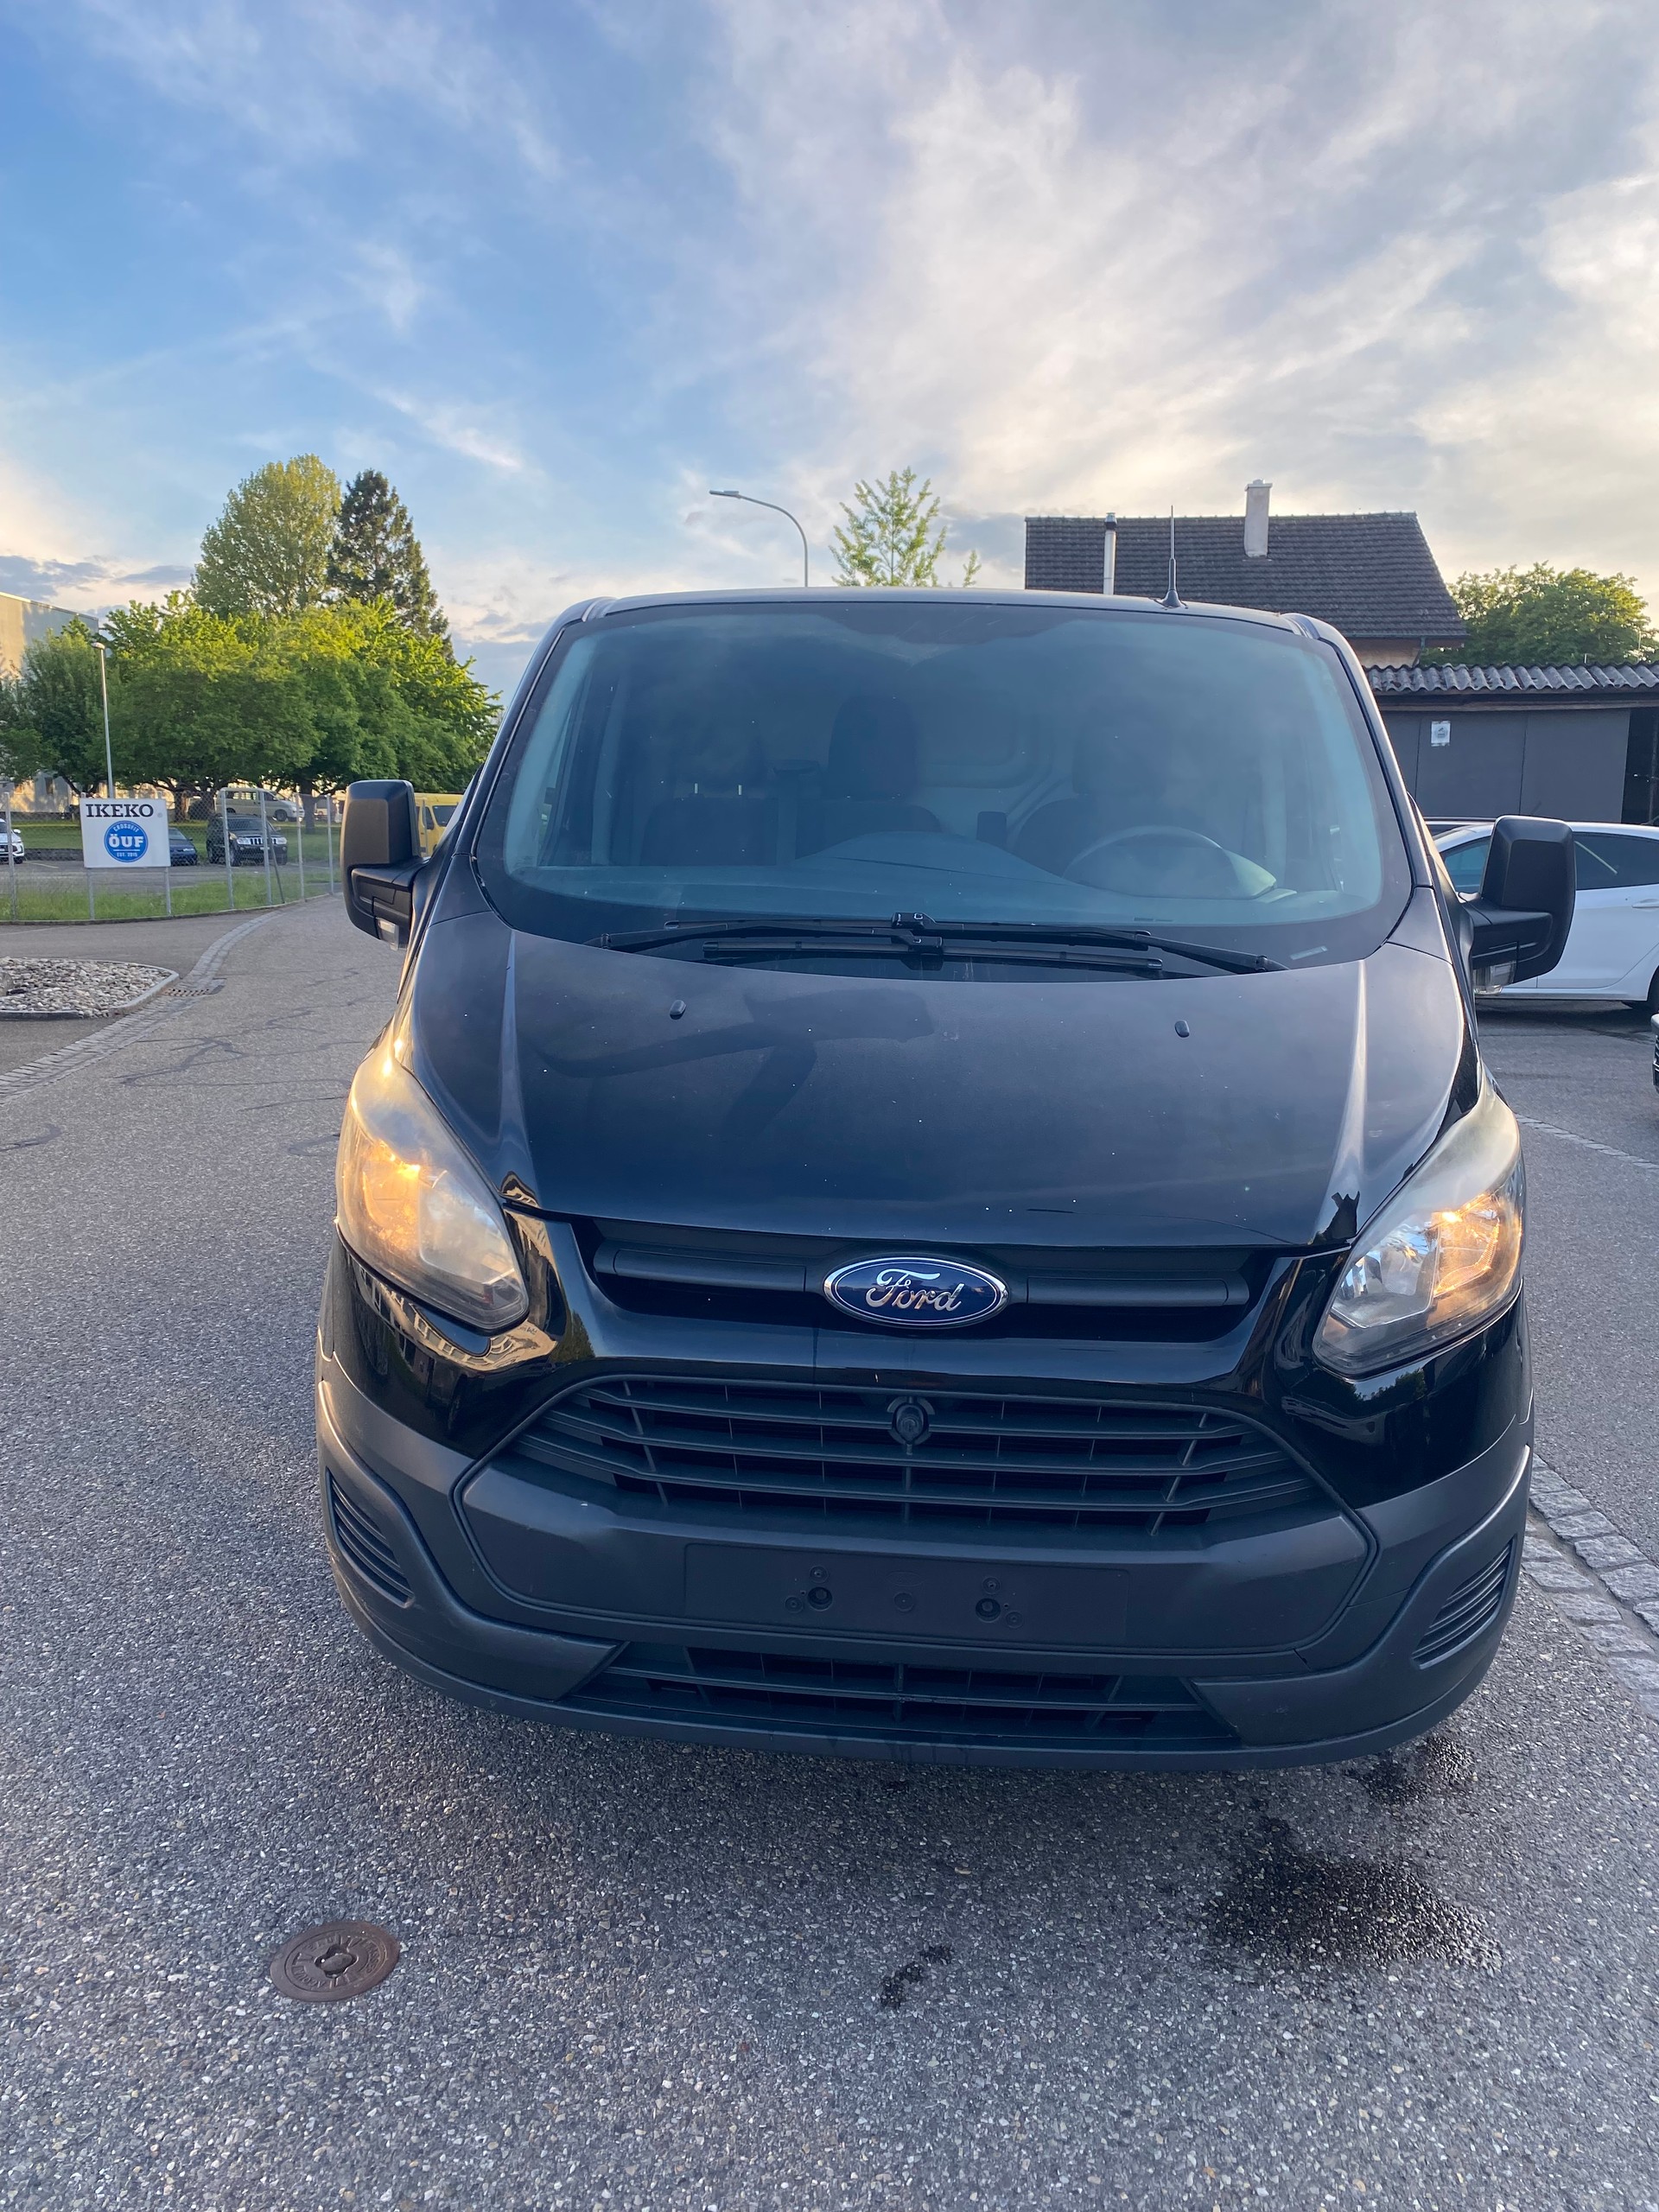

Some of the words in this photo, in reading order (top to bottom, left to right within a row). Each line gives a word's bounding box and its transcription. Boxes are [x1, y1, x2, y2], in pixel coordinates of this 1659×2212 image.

[86, 804, 154, 817] IKEKO
[113, 823, 139, 833] CROSSFIT
[109, 834, 143, 848] ÖUF
[865, 1268, 965, 1312] Ford
